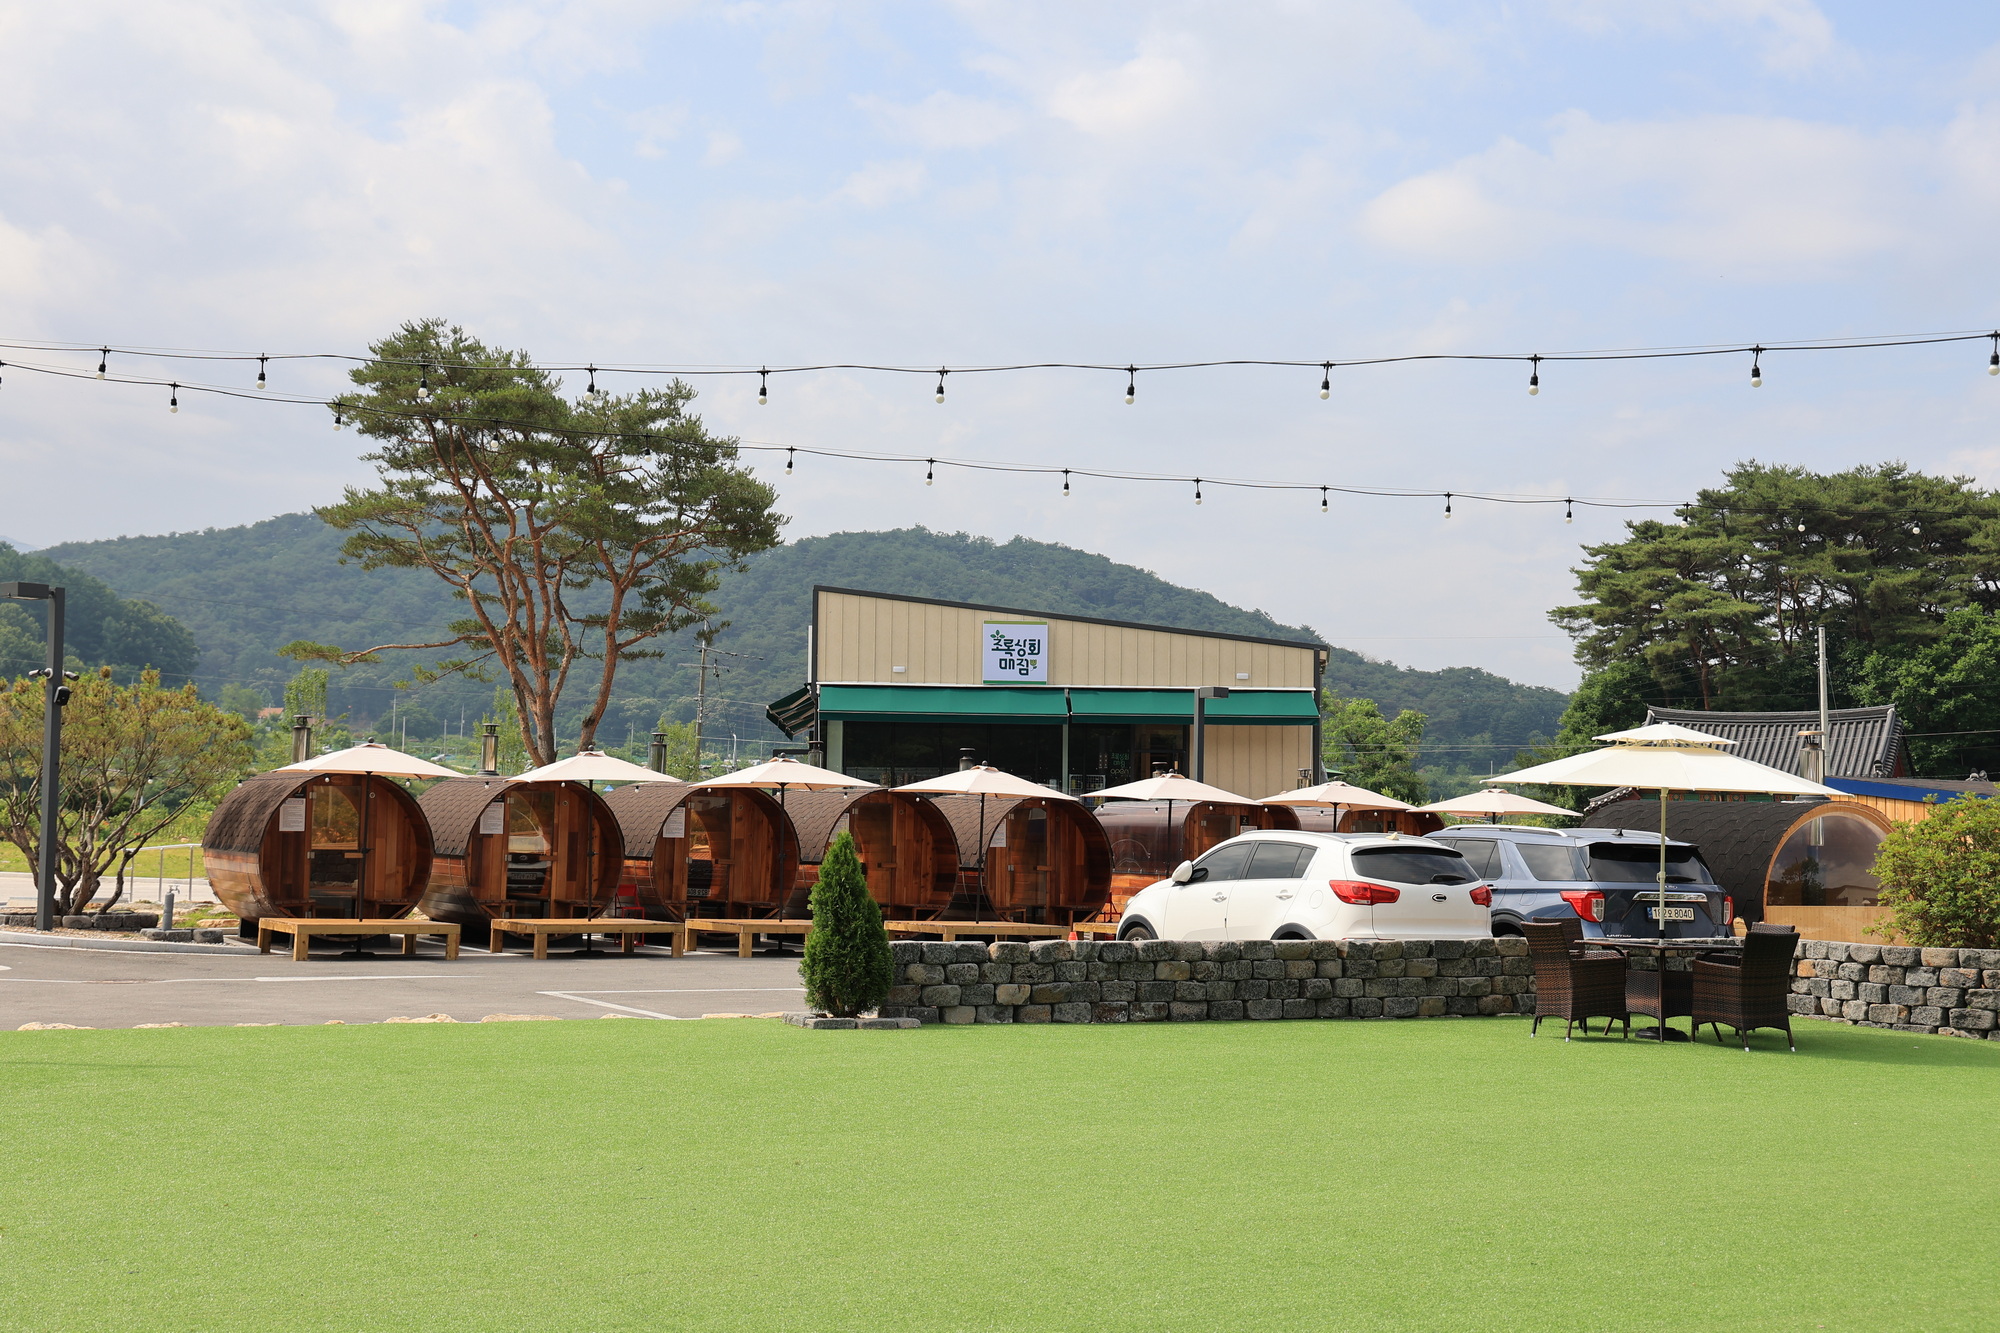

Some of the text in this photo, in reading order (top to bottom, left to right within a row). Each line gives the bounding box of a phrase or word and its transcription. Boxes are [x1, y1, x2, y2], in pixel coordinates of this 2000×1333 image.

[991, 637, 1041, 657] 초록상회
[999, 658, 1029, 676] 매점
[1674, 908, 1693, 919] 8040
